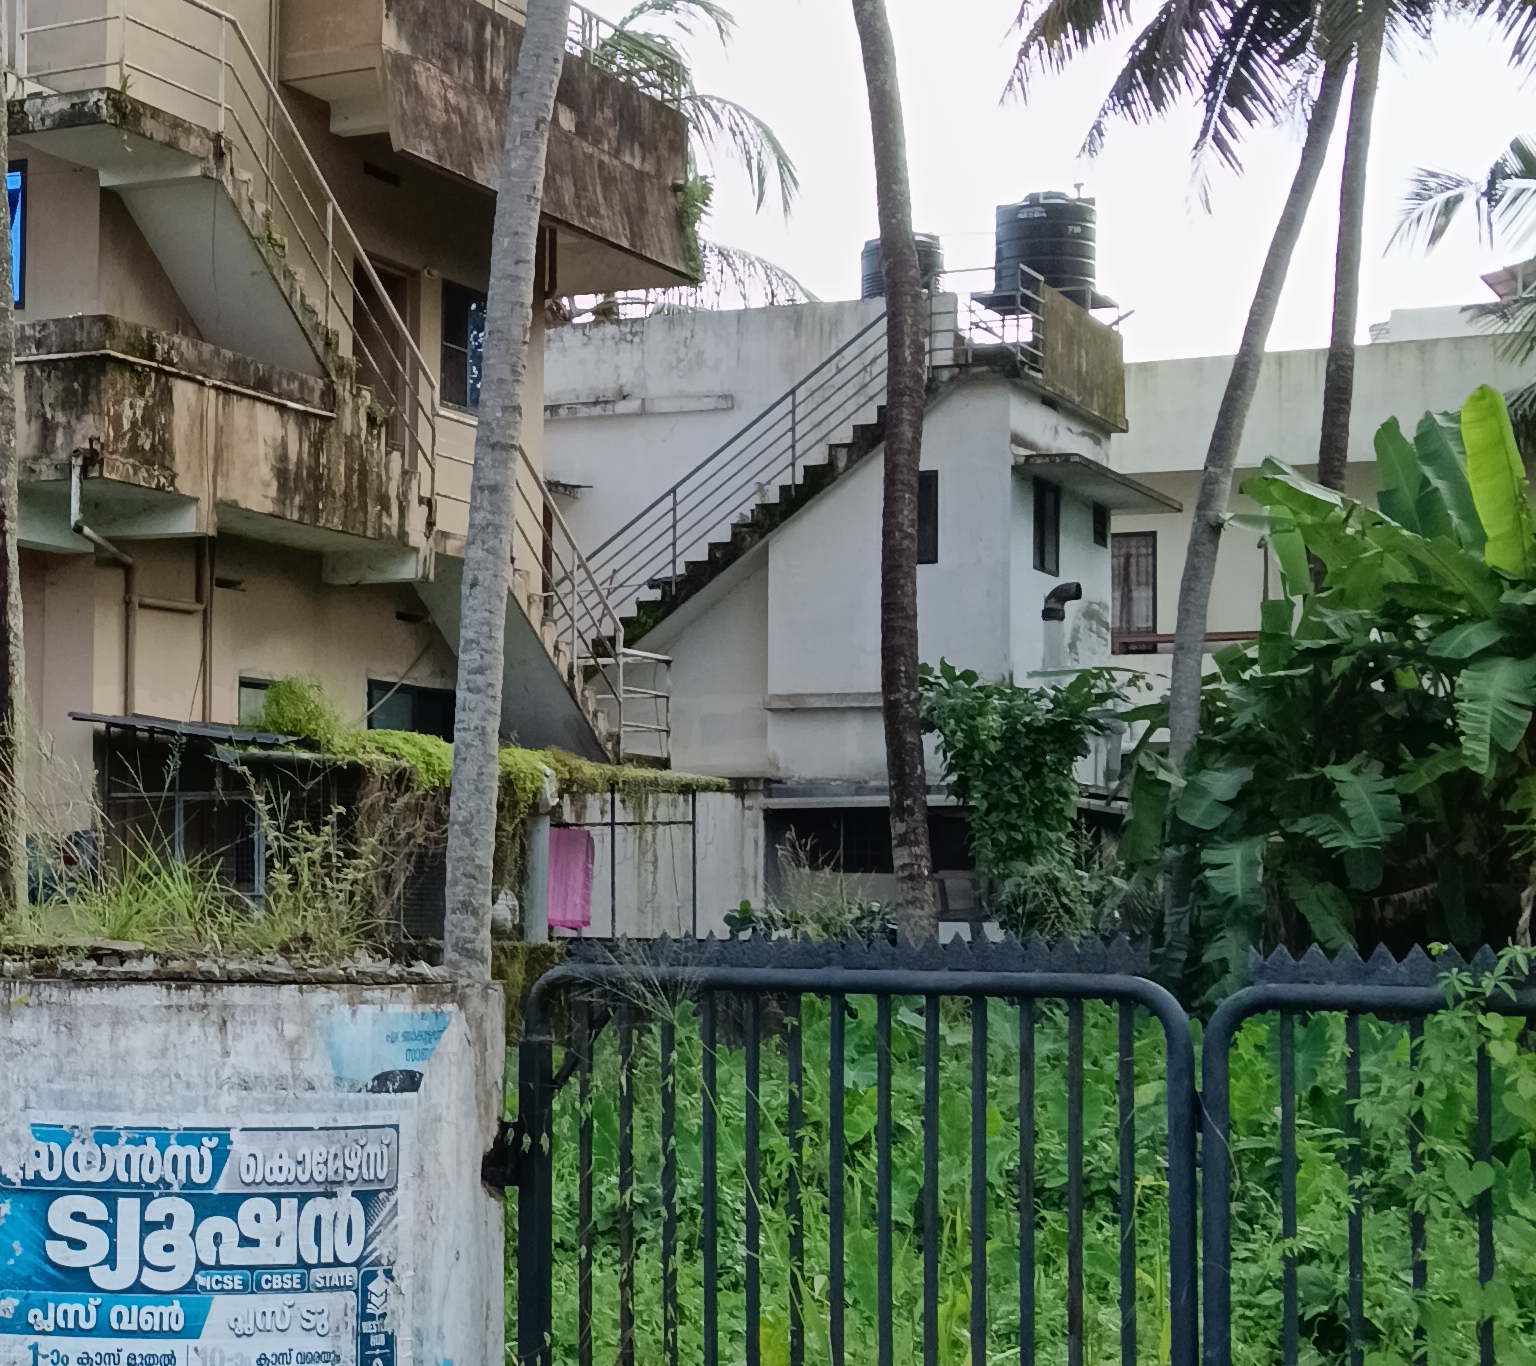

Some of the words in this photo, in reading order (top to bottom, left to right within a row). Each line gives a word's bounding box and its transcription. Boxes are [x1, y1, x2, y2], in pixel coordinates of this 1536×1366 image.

[205, 1273, 244, 1290] ICSE
[260, 1272, 303, 1290] CBSE
[315, 1272, 354, 1288] STATE
[109, 1299, 186, 1333] വൺ
